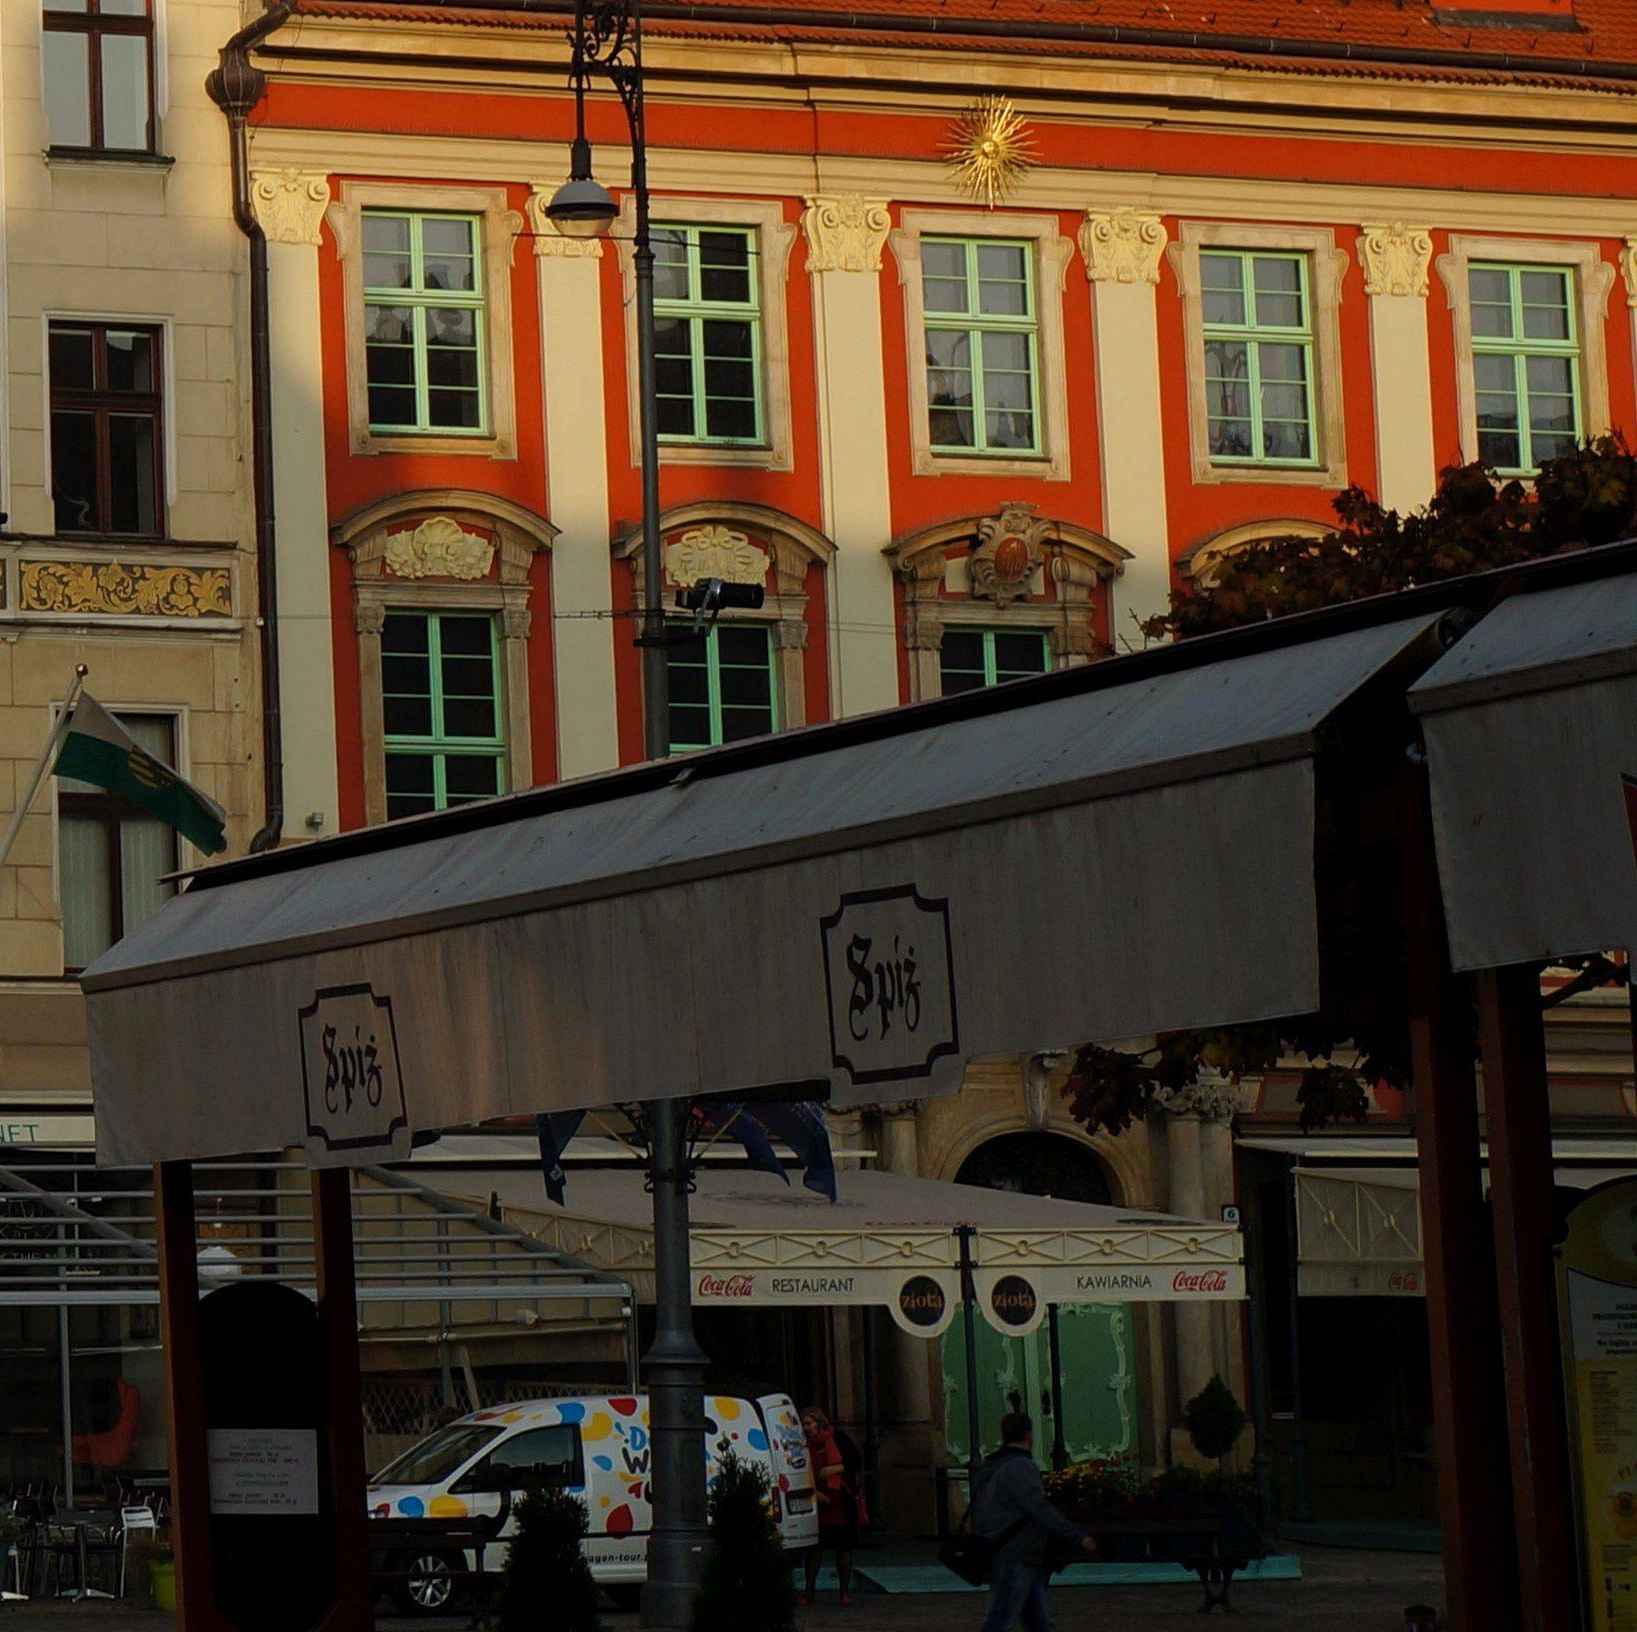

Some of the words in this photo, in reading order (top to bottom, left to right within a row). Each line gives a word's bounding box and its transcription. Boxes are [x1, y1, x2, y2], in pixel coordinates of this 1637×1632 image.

[847, 934, 921, 1041] Spiż
[322, 1023, 382, 1114] Spiż
[772, 1278, 854, 1292] RESTAURANT
[1076, 1275, 1152, 1290] KAWIARNIA
